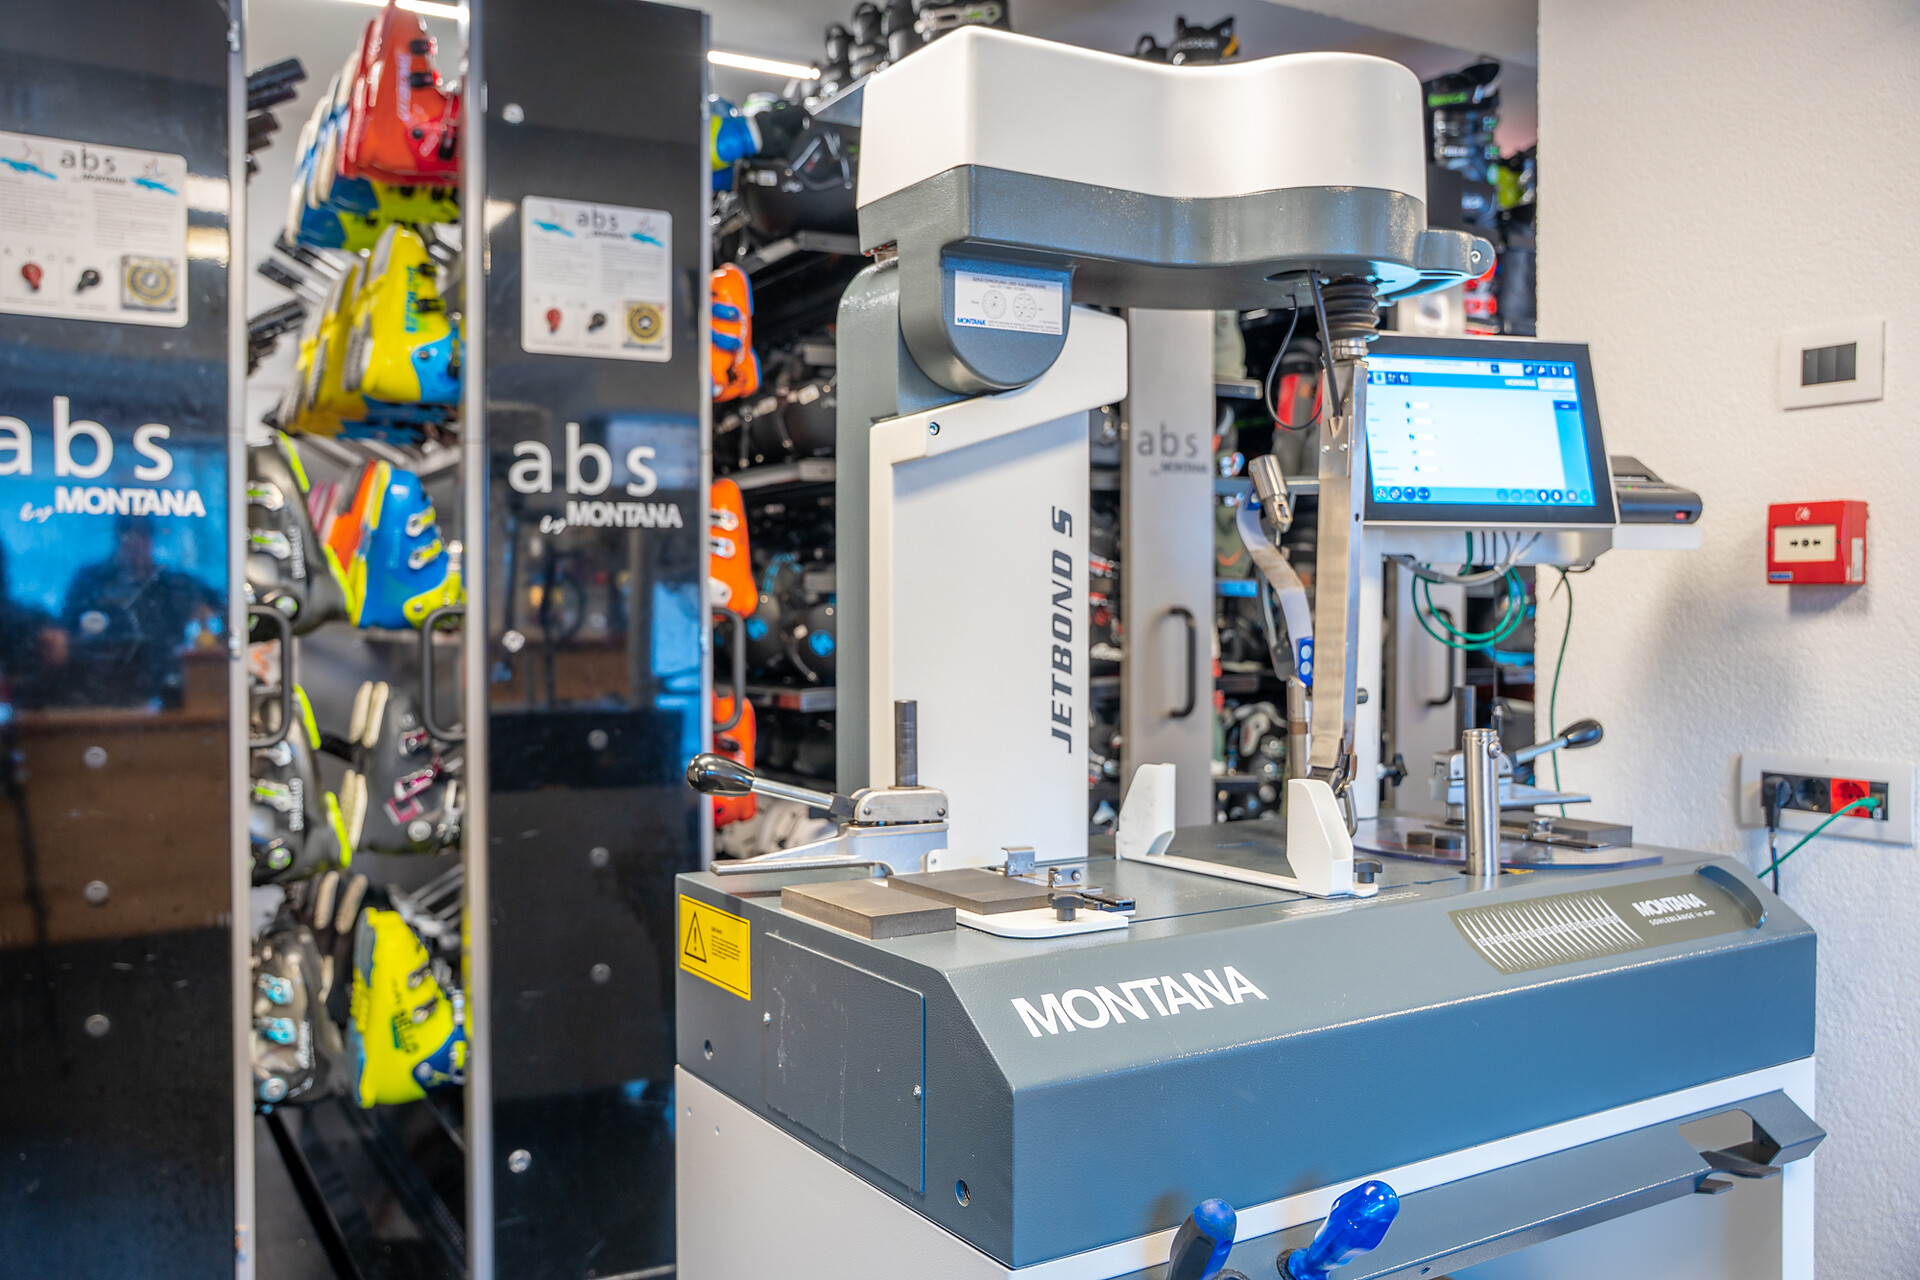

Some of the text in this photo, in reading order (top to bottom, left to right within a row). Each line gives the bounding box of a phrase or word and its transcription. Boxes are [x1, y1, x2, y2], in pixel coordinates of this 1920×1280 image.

[60, 145, 117, 174] abs
[575, 207, 619, 232] abs
[957, 317, 987, 326] MONTANA
[1137, 422, 1199, 458] abs
[508, 422, 658, 497] abs
[55, 486, 206, 518] MONTANA
[566, 500, 683, 528] MONTANA
[1051, 505, 1073, 754] JETBOND S
[1631, 893, 1708, 917] MONTANA
[1010, 965, 1269, 1038] MONTANA
